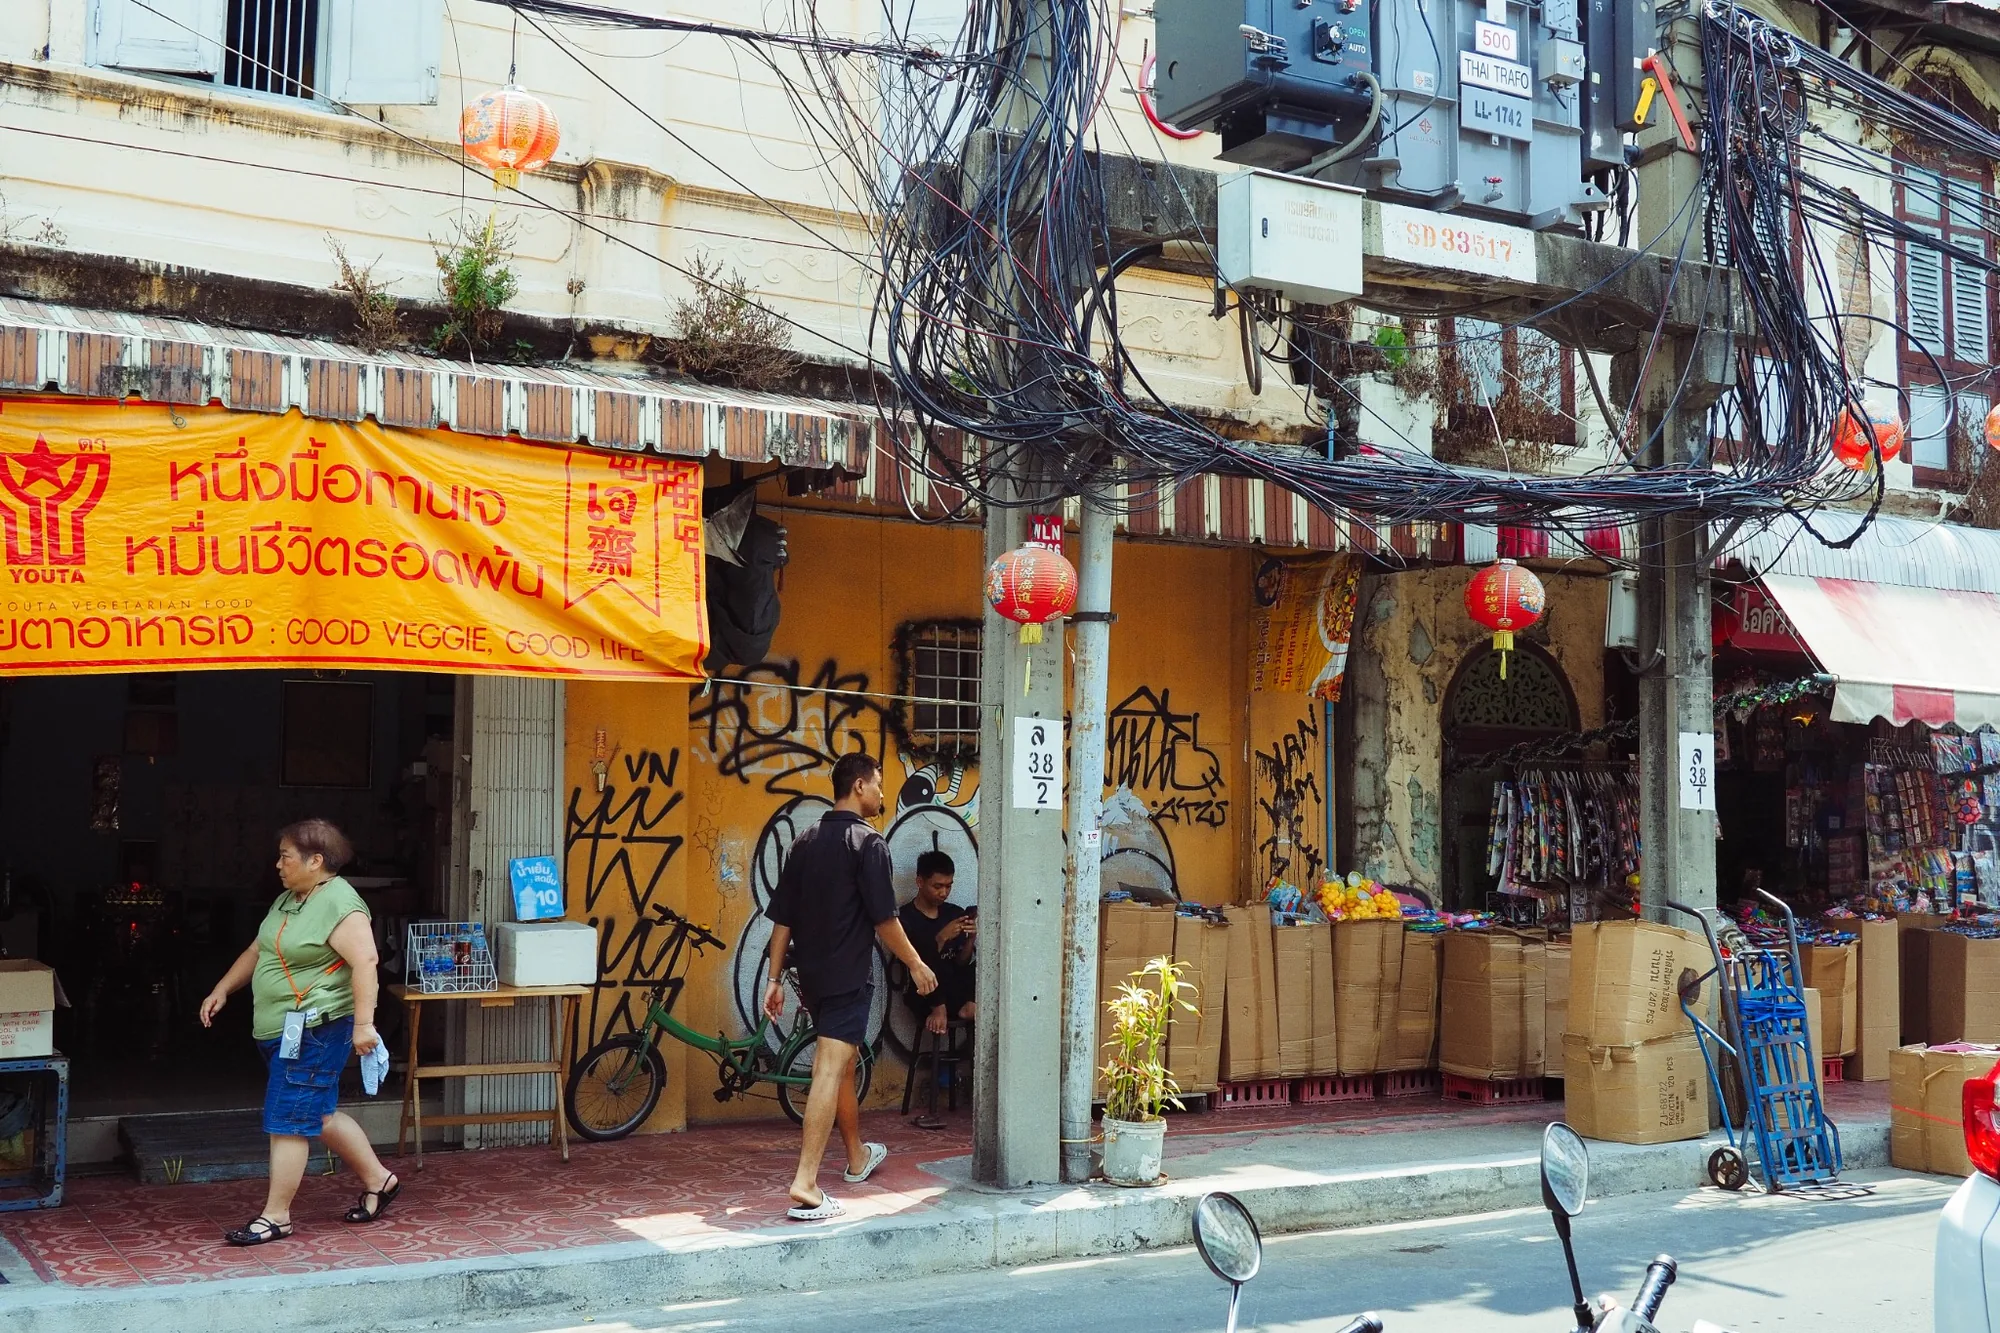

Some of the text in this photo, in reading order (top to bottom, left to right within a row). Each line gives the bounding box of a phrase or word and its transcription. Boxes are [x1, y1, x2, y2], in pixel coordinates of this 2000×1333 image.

[1349, 27, 1366, 38] OPEN
[1482, 29, 1511, 51] 500
[1349, 43, 1366, 54] AUTO
[1464, 58, 1529, 89] THAI TRAFO
[588, 483, 637, 525] เจ
[9, 569, 85, 584] YOUTA
[0, 598, 253, 612] OUTA VEGETARIAN FOOD
[286, 618, 370, 646] GOOD
[383, 620, 493, 655] VEGGIE,
[505, 630, 591, 659] GOOD
[601, 638, 645, 662] LIFE
[1028, 752, 1054, 774] 38
[1689, 767, 1707, 784] 38
[1037, 781, 1048, 804] 2
[1697, 787, 1702, 804] 1
[536, 889, 558, 906] 10
[1648, 991, 1657, 1007] 240
[1646, 1008, 1655, 1024] PCS
